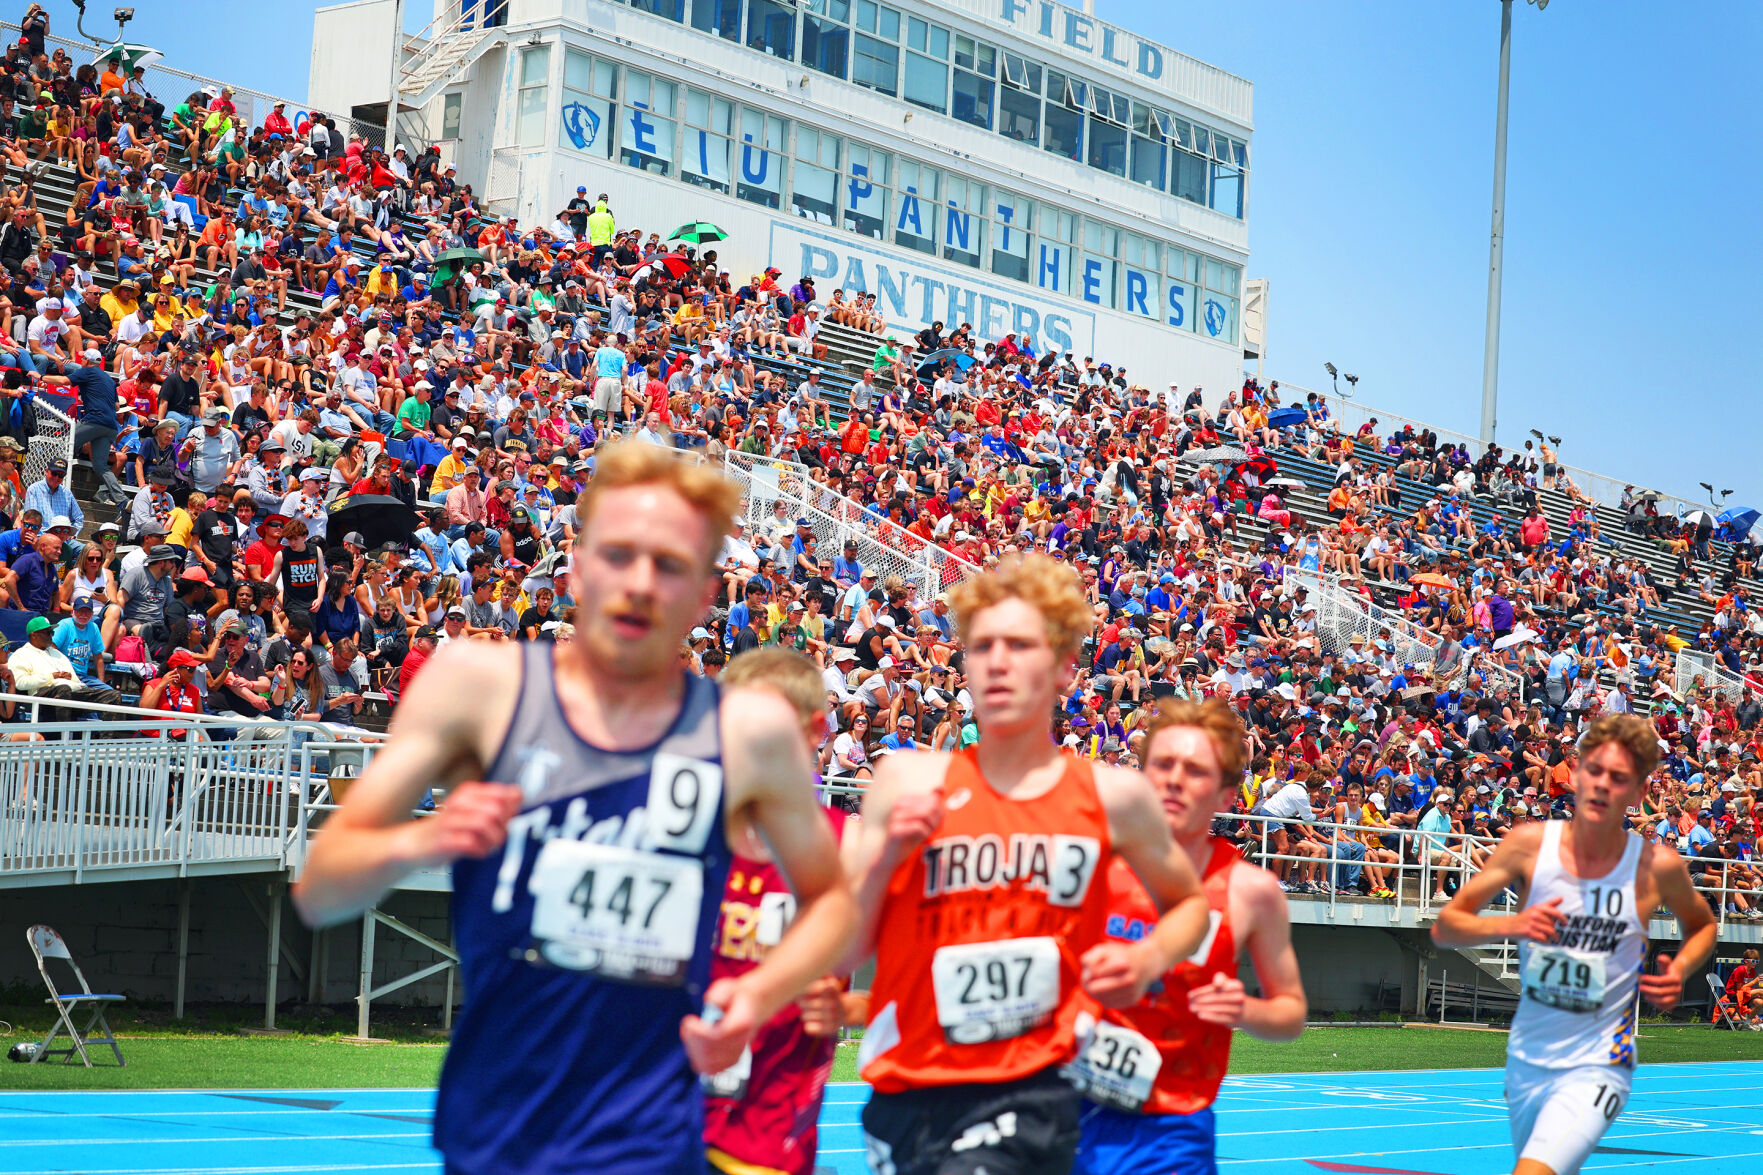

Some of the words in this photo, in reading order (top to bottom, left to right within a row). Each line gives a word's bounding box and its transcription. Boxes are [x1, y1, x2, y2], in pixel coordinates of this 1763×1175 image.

[1000, 0, 1163, 80] FIELD
[800, 242, 1074, 359] PANTHERS
[290, 563, 317, 575] RUN
[666, 768, 700, 838] 9
[924, 840, 1051, 893] TROJA
[1059, 844, 1087, 899] 3
[568, 869, 673, 930] 447
[1590, 885, 1624, 917] 10
[956, 956, 1033, 1005] 297
[1539, 955, 1592, 990] 719
[1082, 1033, 1142, 1080] 36
[1593, 1083, 1621, 1121] 10
